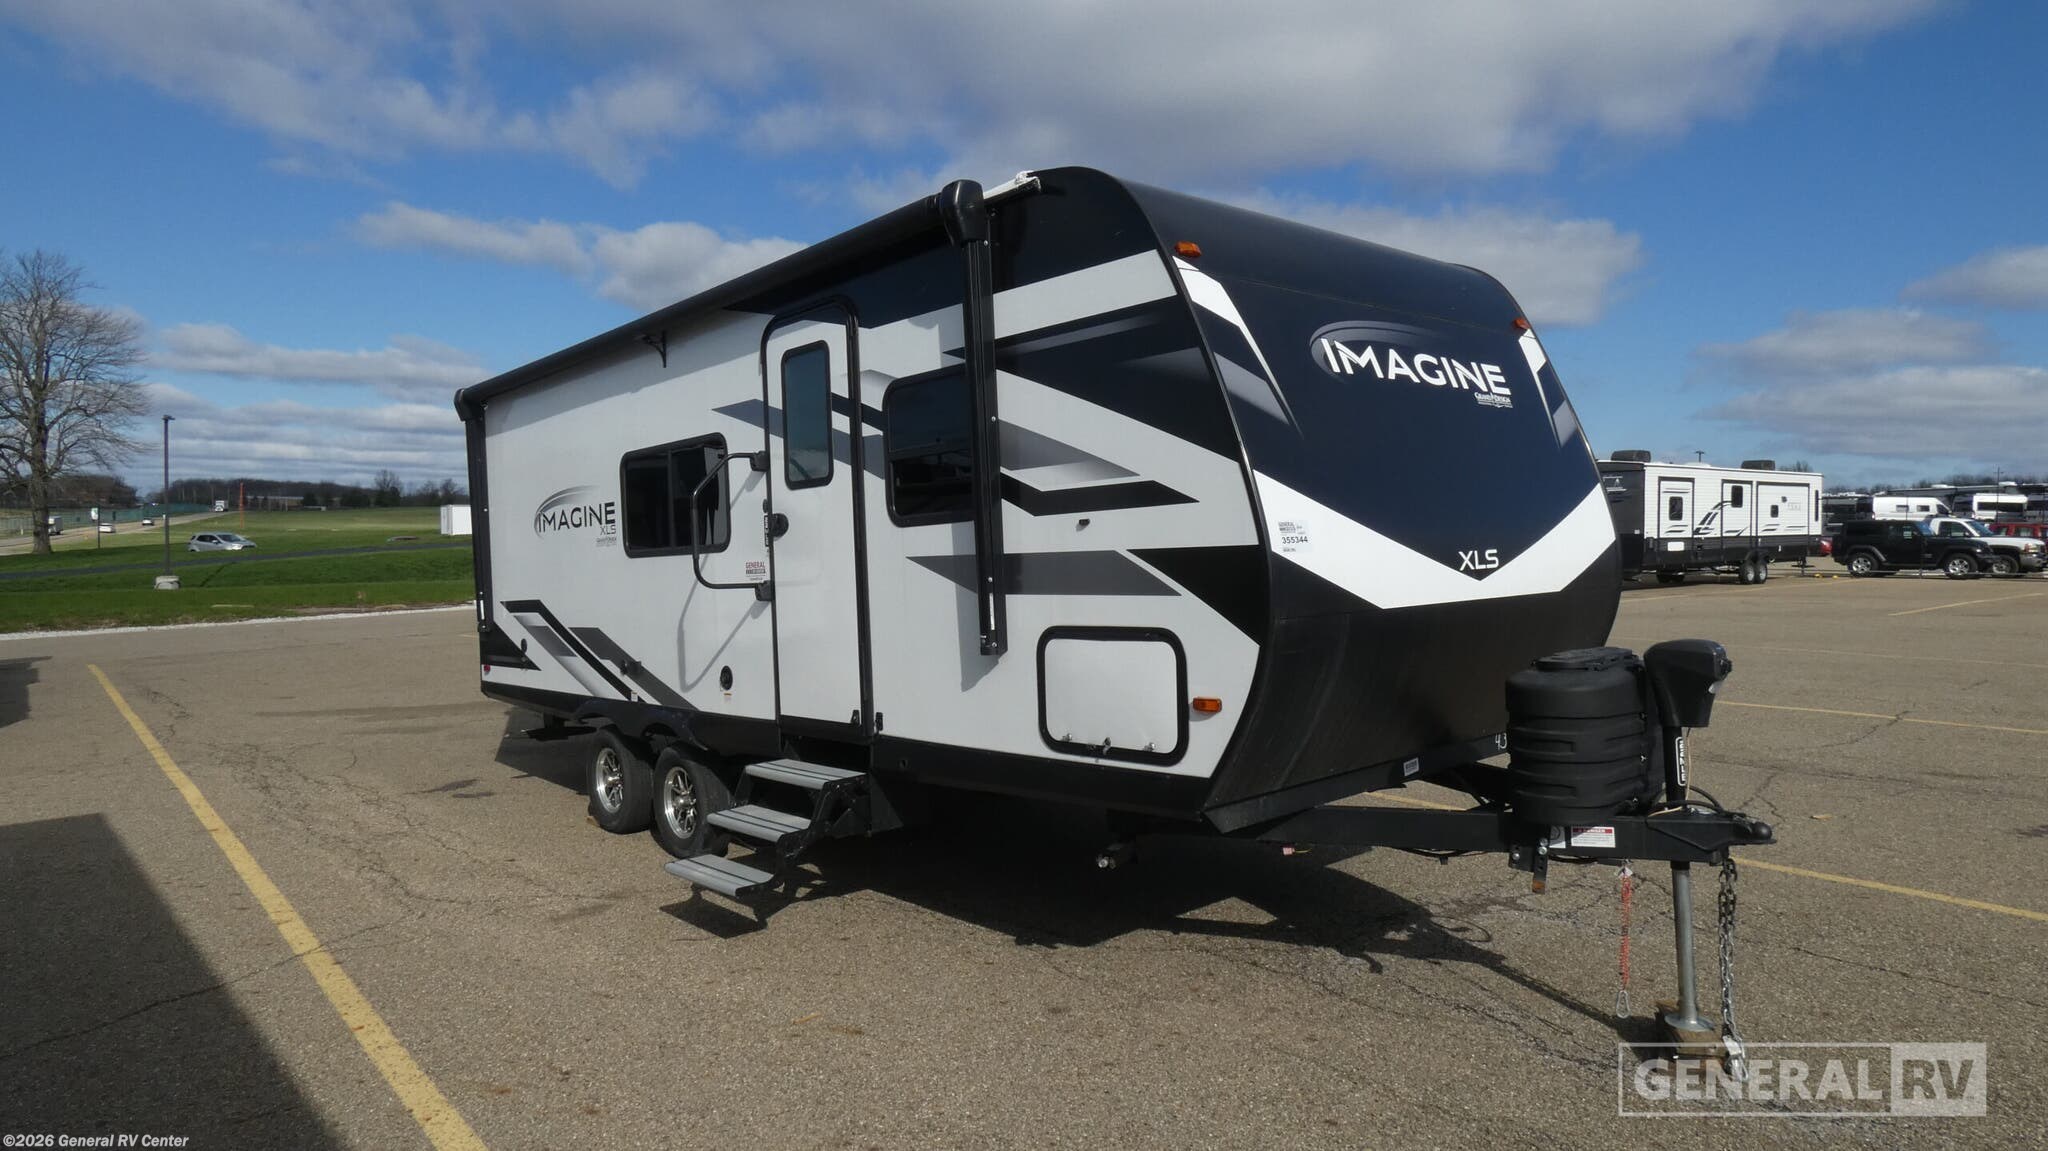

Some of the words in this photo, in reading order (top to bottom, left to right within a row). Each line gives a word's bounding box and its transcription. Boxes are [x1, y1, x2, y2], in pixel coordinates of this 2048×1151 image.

[1321, 338, 1511, 396] IMAGINE
[537, 502, 616, 532] IMAGINE
[600, 525, 616, 535] XLS
[1282, 536, 1309, 544] 355344
[1458, 549, 1499, 571] XLS
